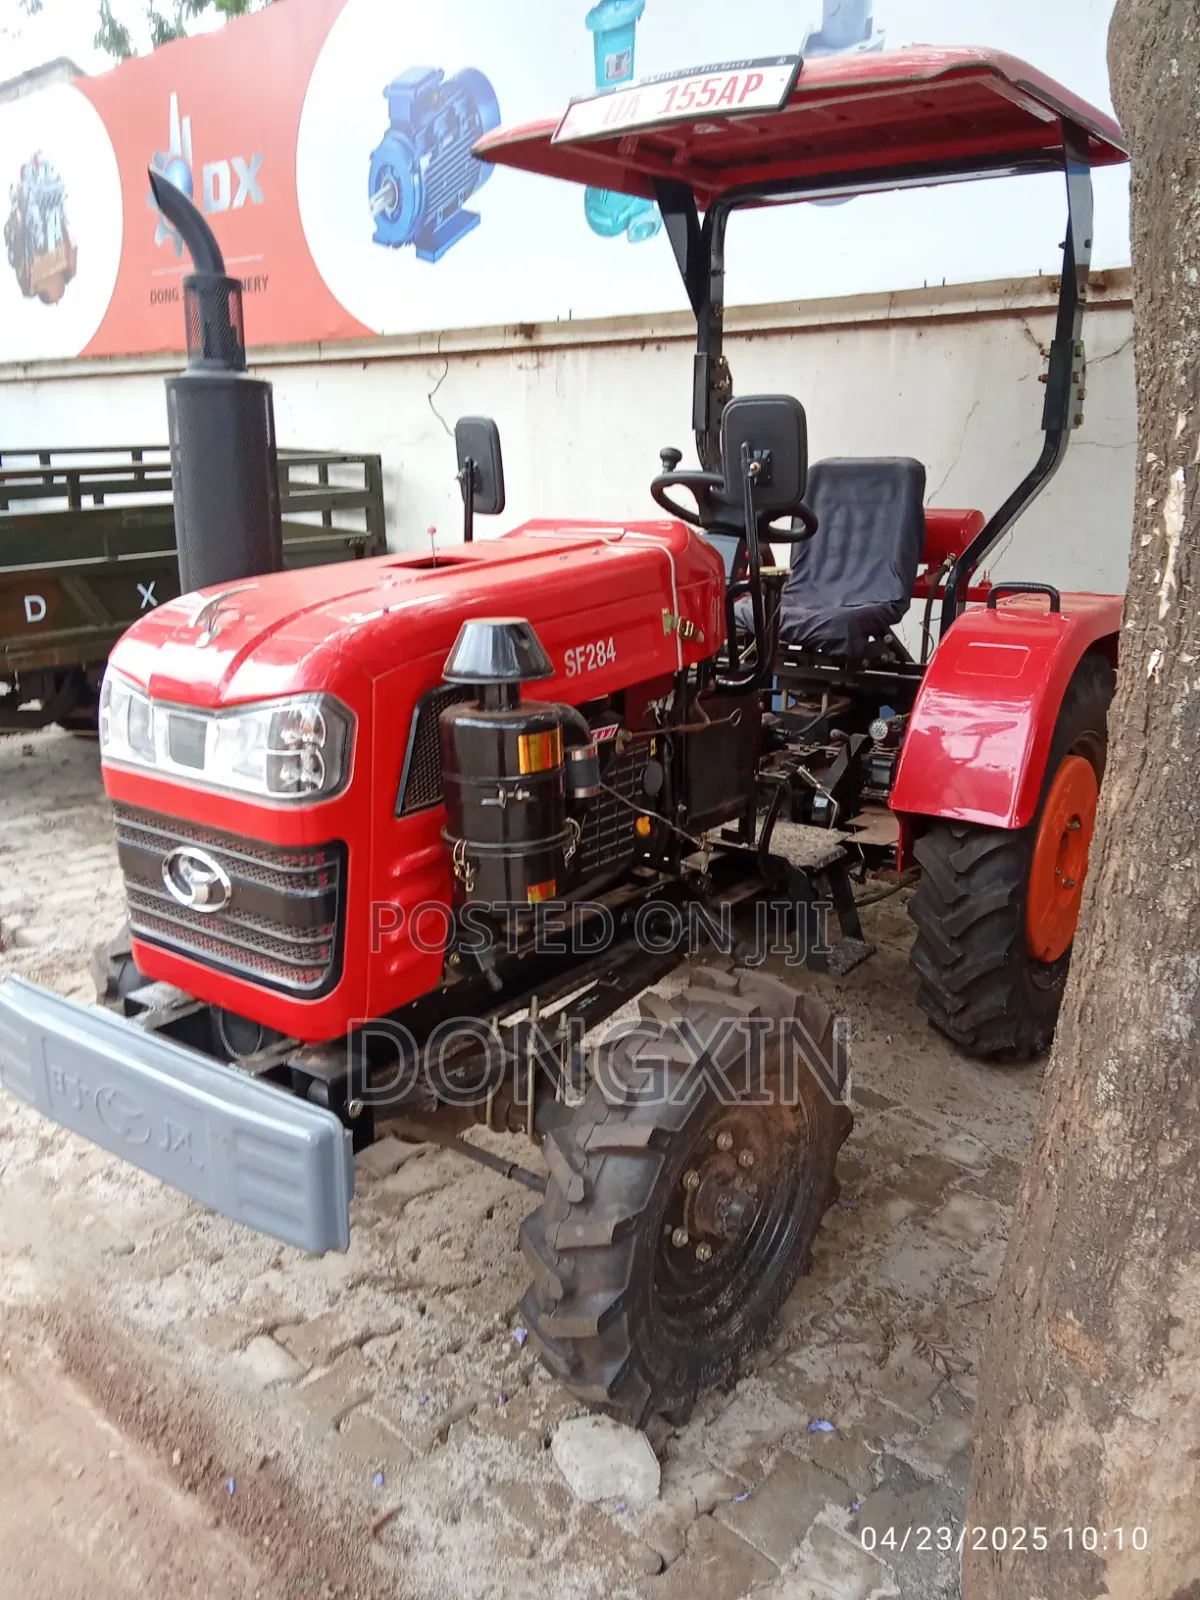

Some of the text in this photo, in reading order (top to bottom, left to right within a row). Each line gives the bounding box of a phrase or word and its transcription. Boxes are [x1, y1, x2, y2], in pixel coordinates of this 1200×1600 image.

[656, 73, 764, 115] 155AP
[203, 153, 264, 214] DX
[150, 286, 179, 305] DONG
[564, 636, 617, 678] SF284
